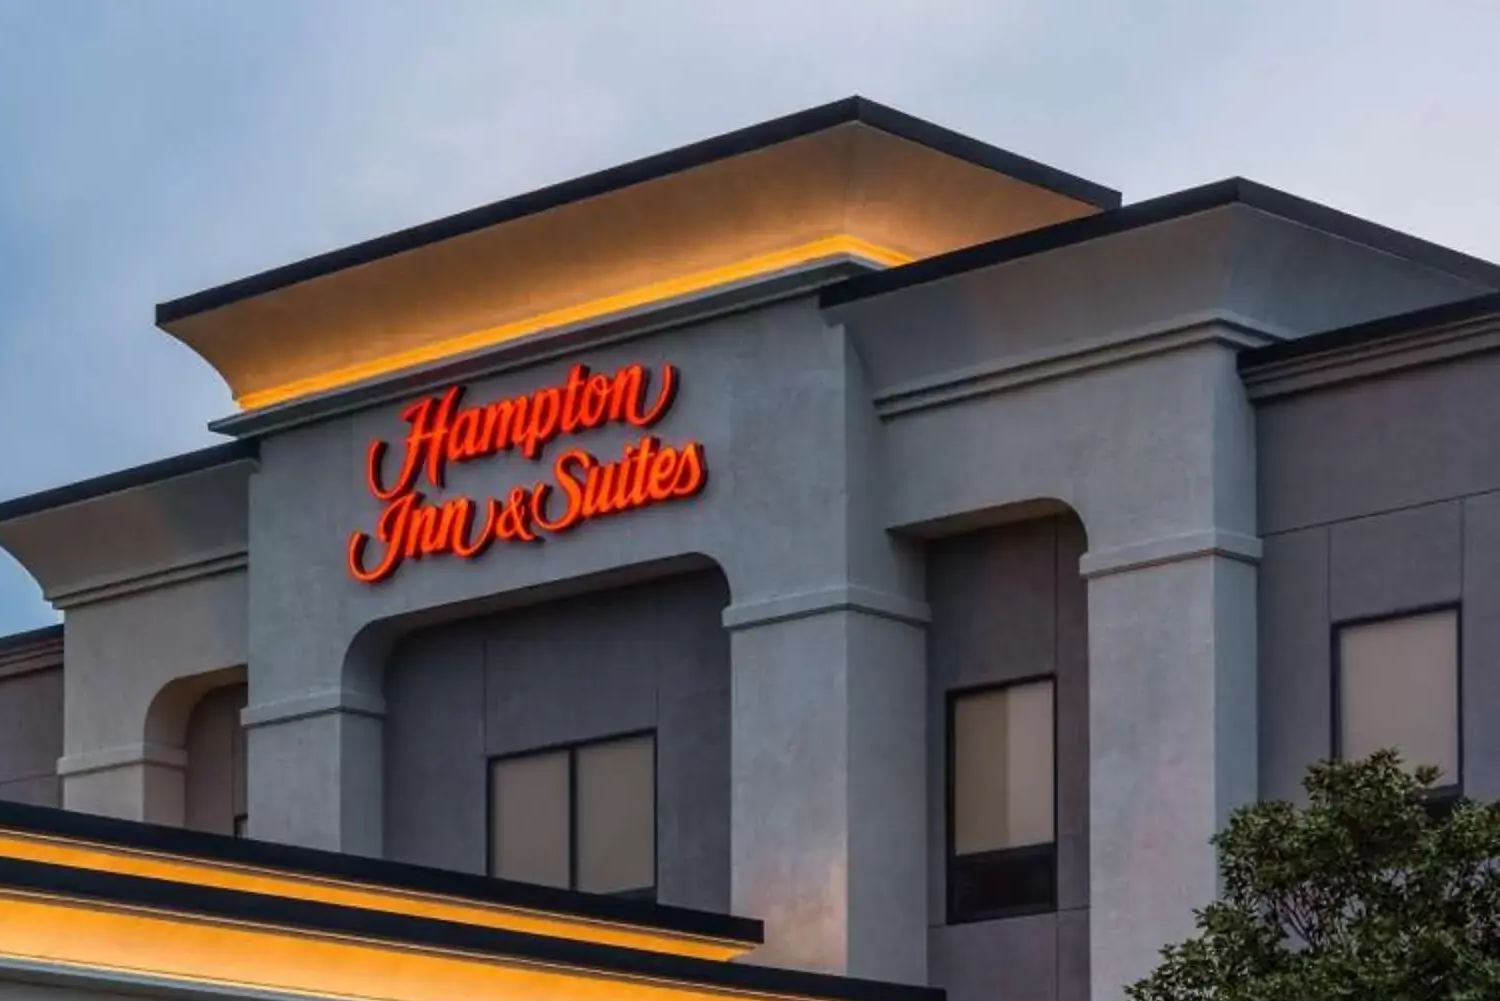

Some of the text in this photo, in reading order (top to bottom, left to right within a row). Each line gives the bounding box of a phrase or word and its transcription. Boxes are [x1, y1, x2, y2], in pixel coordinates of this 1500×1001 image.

[368, 362, 679, 501] Hampton
[348, 436, 706, 583] Inn & Suites
